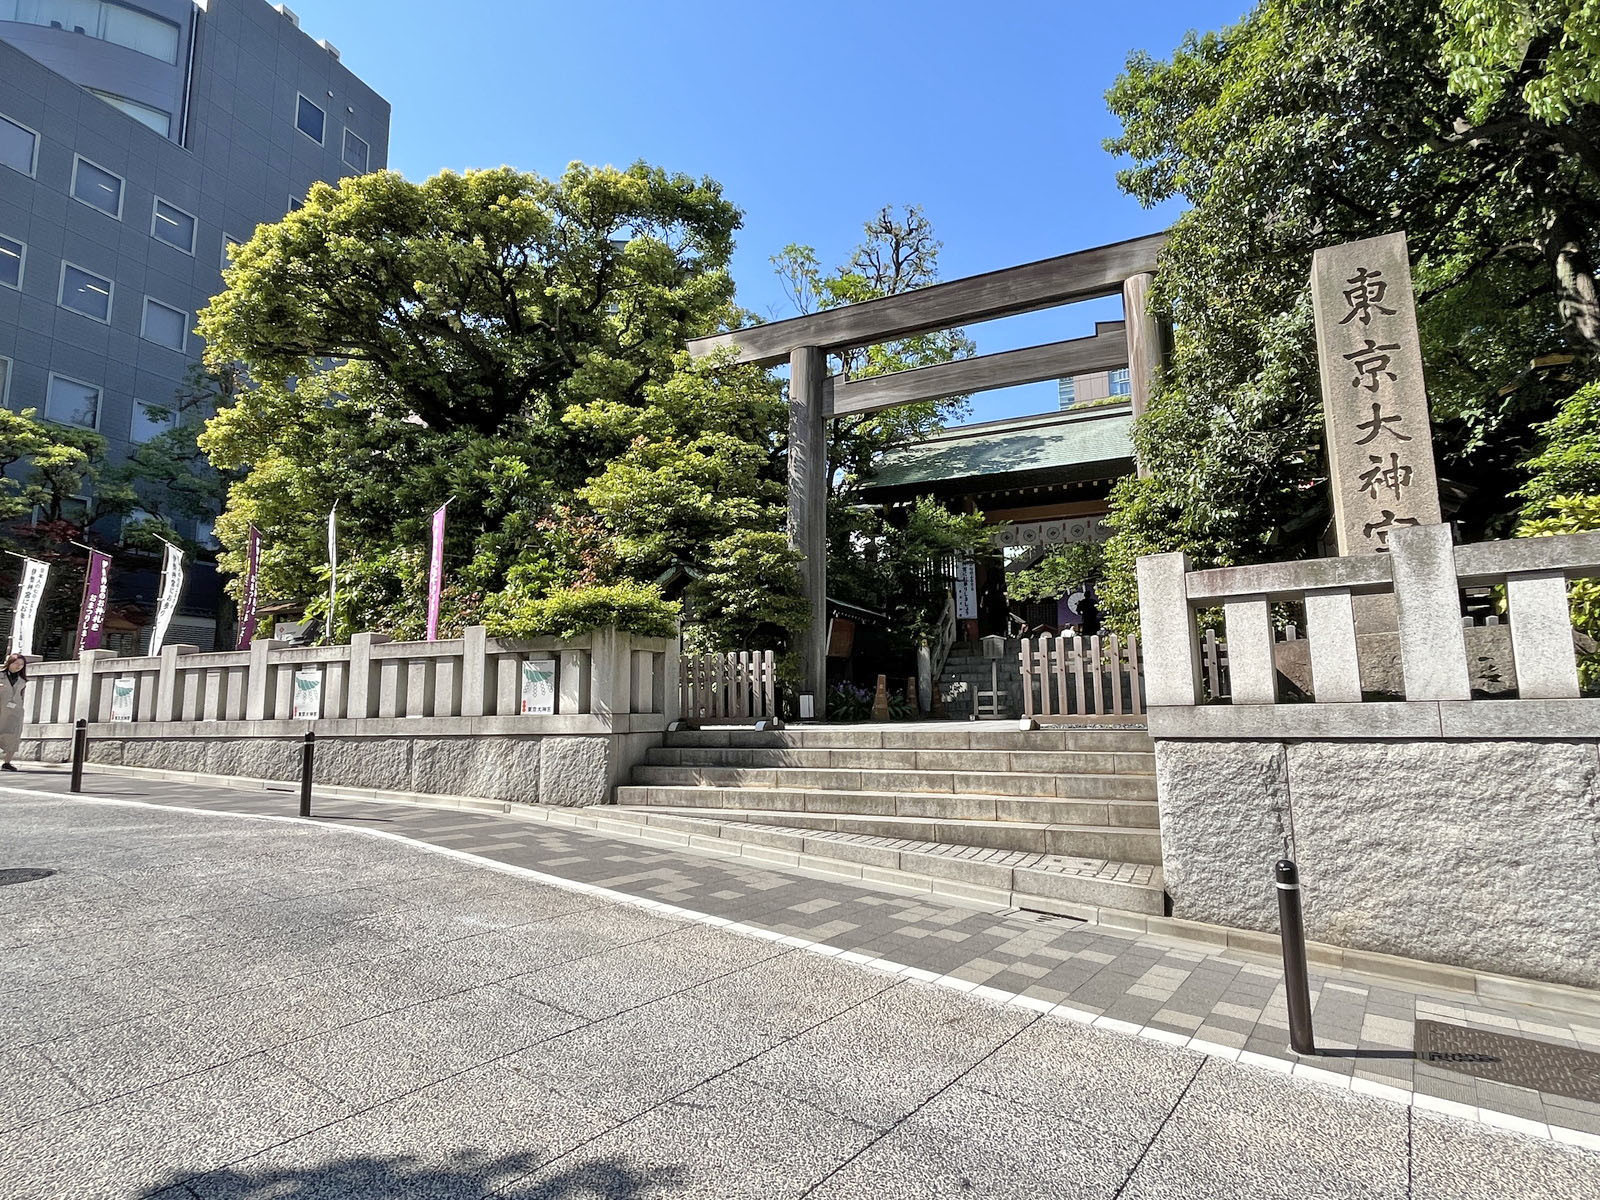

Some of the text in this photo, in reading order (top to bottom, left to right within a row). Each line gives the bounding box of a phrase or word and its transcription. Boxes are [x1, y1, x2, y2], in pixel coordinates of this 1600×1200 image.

[78, 594, 97, 658] おまつりしましょ
